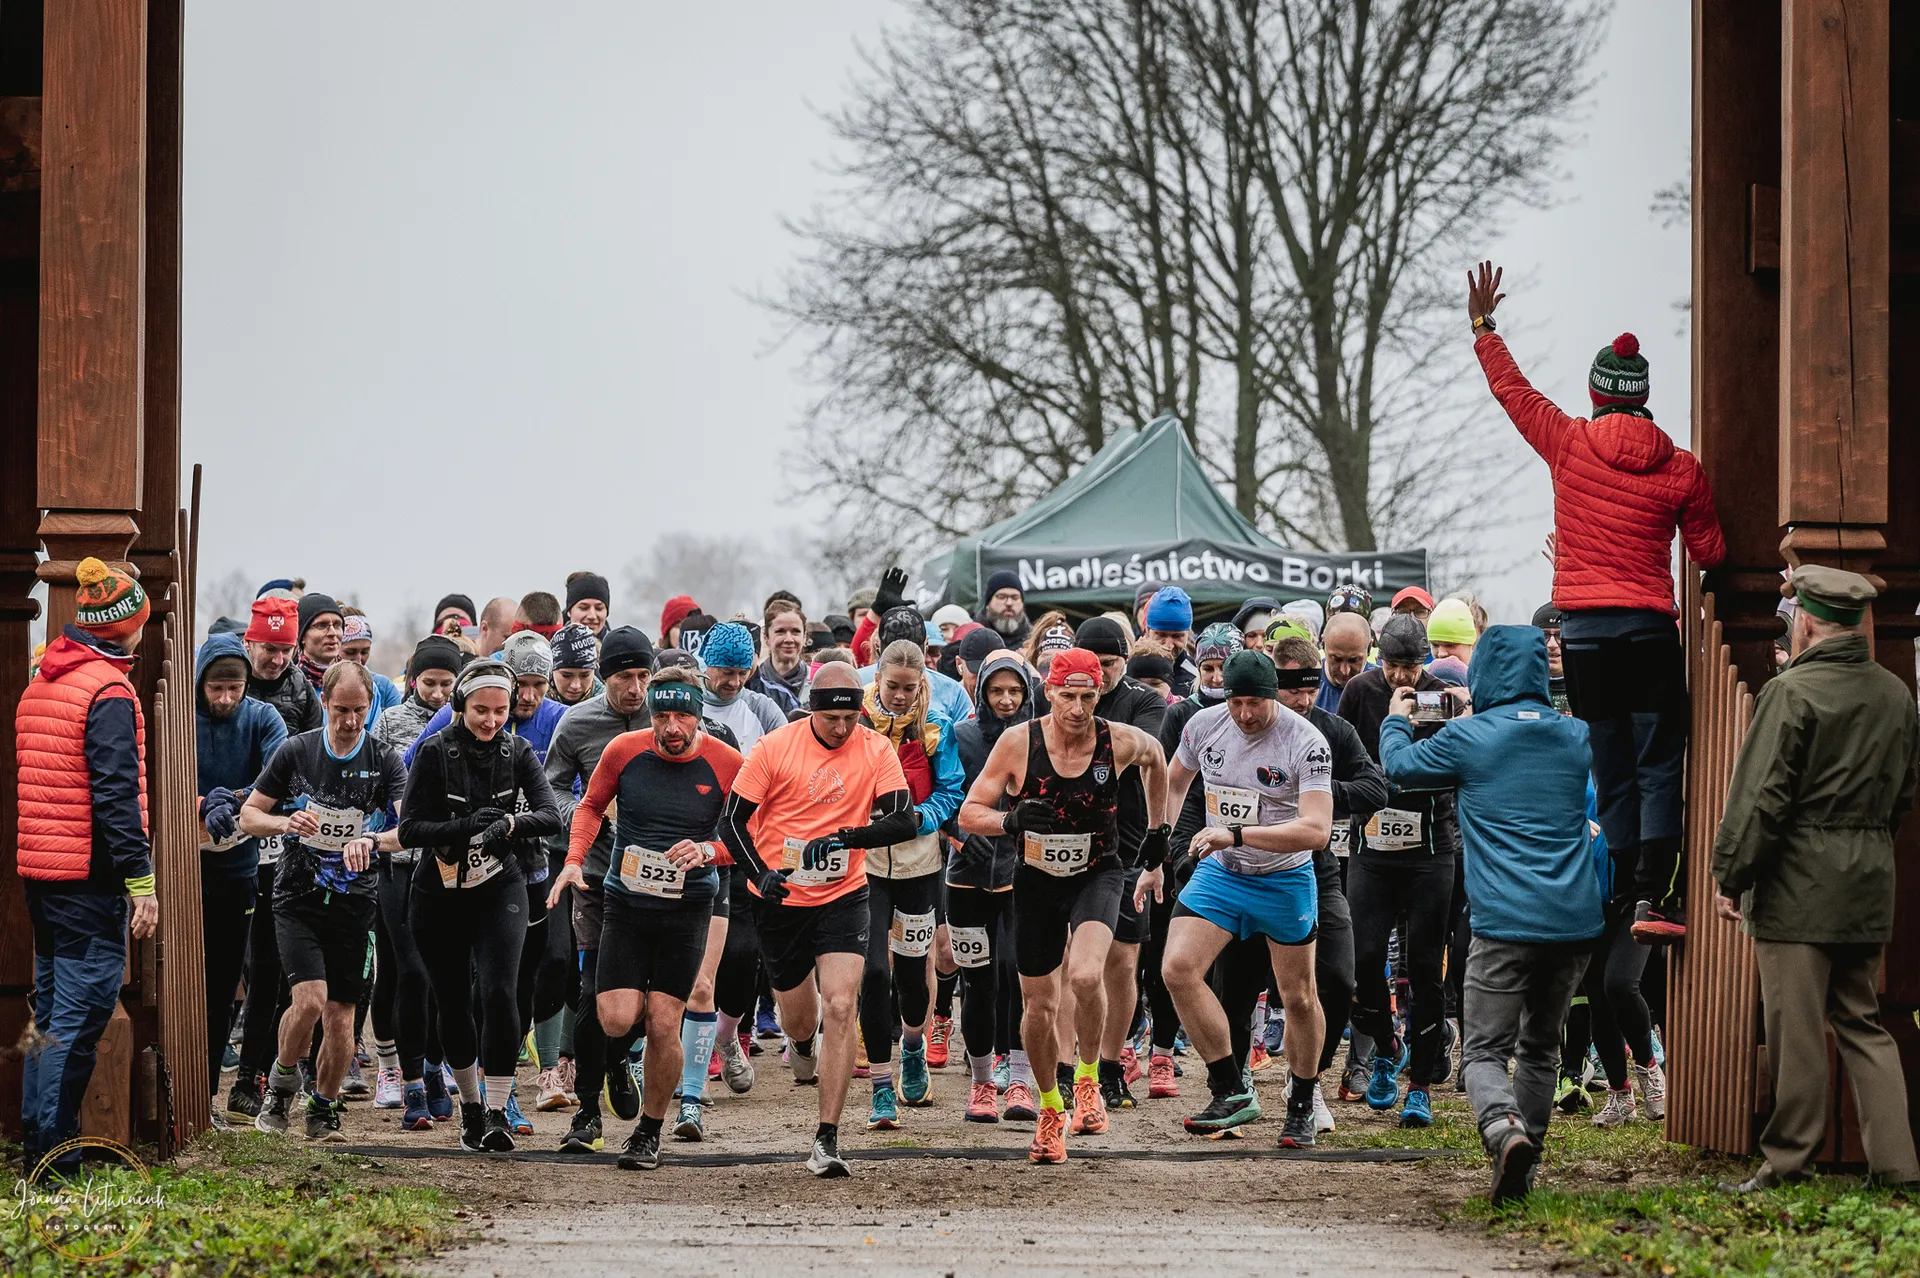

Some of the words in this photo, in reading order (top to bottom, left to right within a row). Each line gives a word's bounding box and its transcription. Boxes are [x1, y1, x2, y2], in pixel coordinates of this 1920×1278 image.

[1592, 372, 1612, 390] TRAIL
[1018, 550, 1270, 592] Nadleśnictwo
[1282, 557, 1383, 590] Borki
[1220, 802, 1252, 819] 667
[320, 822, 355, 838] 652
[1380, 822, 1414, 837] 562
[1044, 848, 1084, 863] 503
[809, 857, 842, 872] 05
[640, 864, 678, 883] 523
[904, 926, 933, 943] 508
[951, 938, 983, 955] 509
